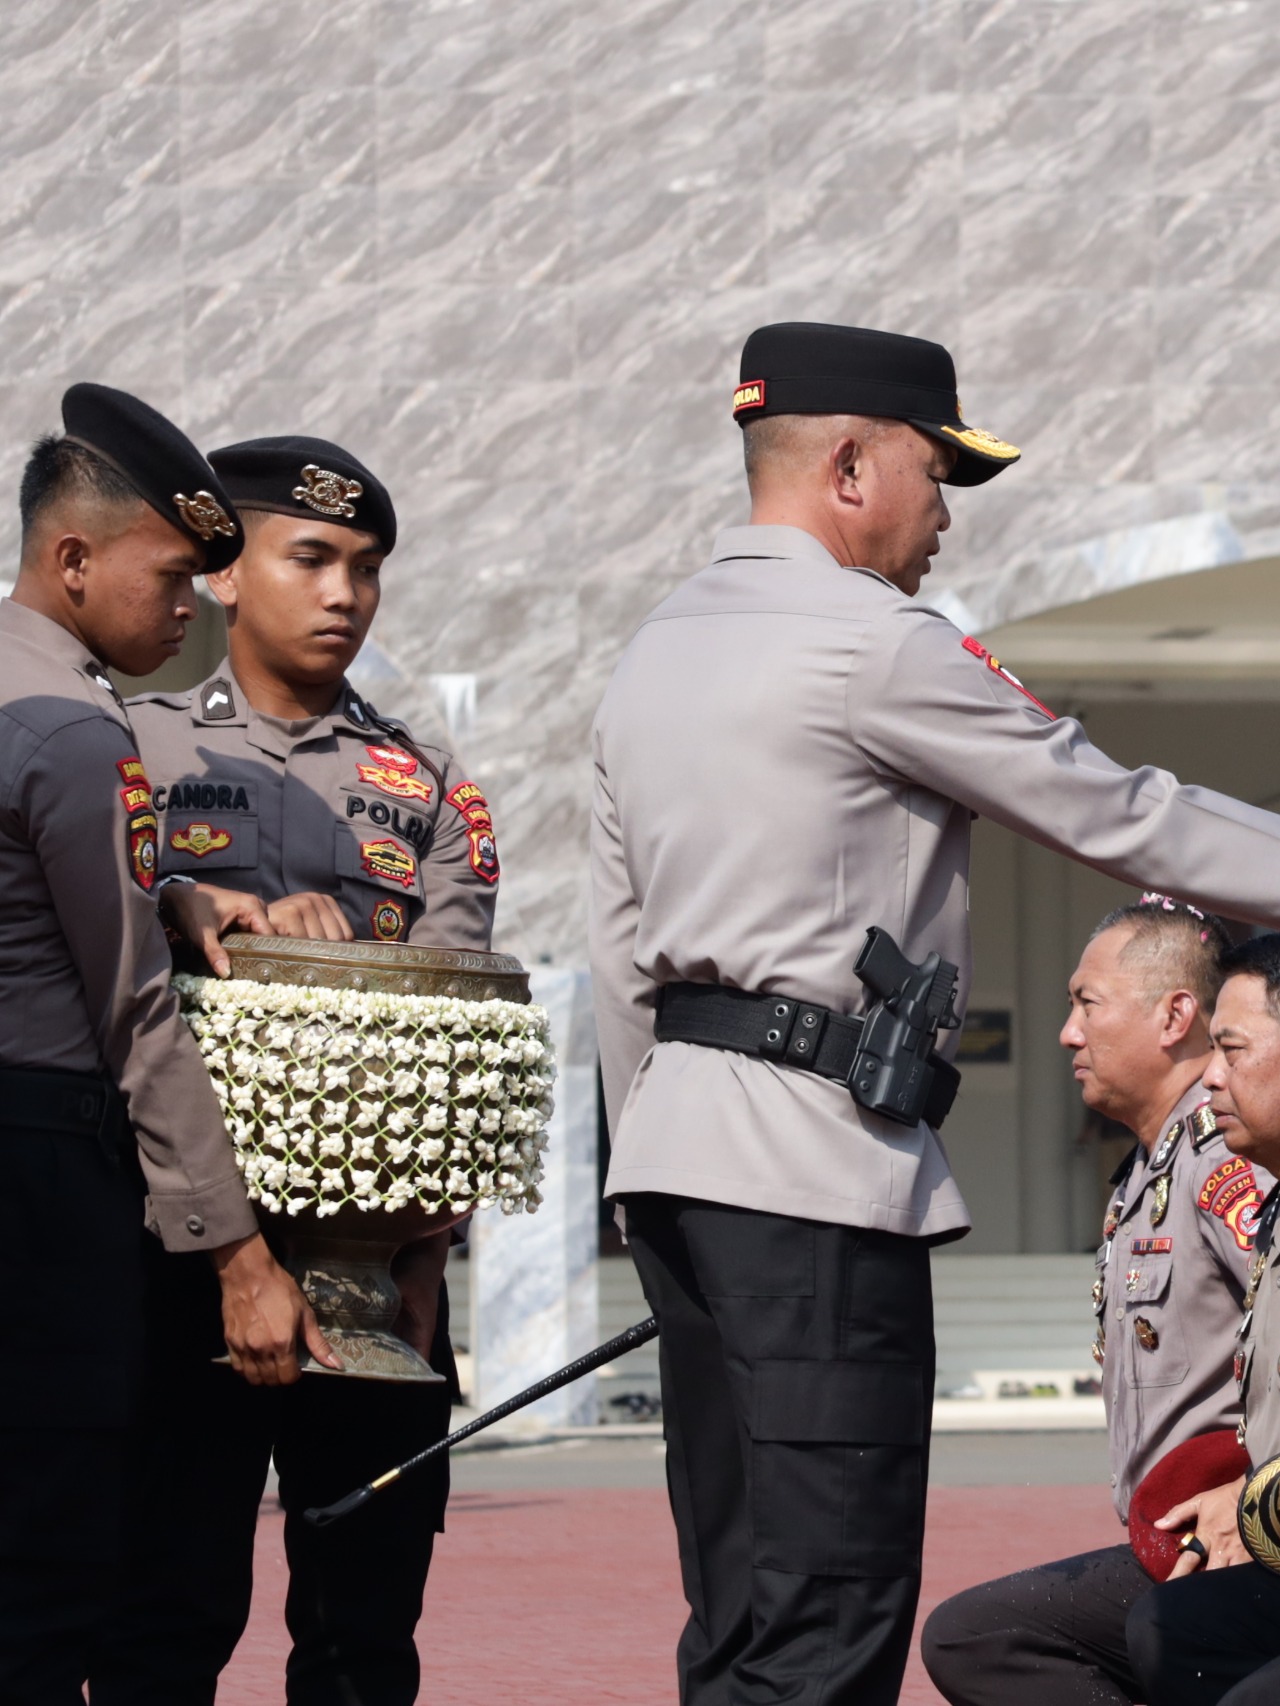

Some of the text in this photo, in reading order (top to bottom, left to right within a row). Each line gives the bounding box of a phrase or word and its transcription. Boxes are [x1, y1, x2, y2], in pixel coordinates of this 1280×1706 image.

[152, 784, 250, 811] CANDRA
[1201, 1158, 1246, 1203] POLDA
[1215, 1176, 1251, 1212] BANTEN
